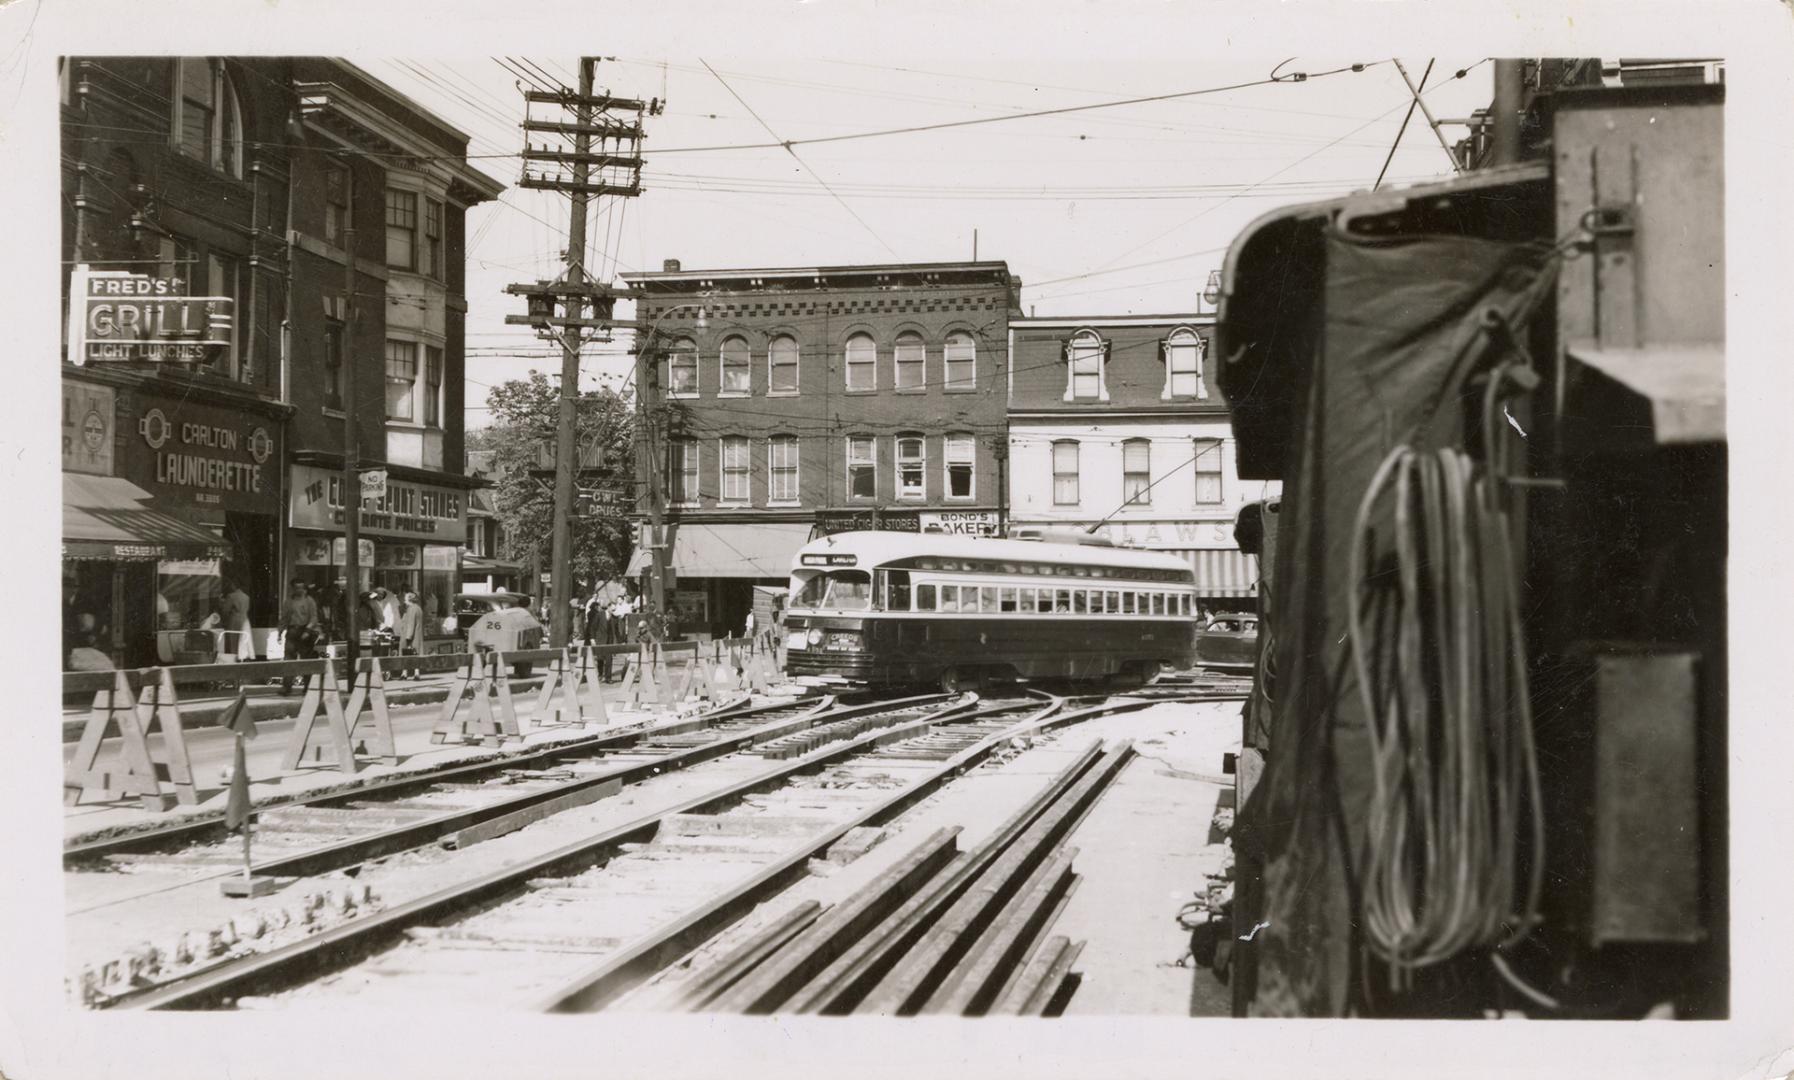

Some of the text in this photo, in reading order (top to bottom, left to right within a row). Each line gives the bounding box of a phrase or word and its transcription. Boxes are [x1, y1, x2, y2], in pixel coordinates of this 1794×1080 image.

[91, 278, 168, 295] FRED'S
[89, 303, 201, 337] GRILL
[89, 343, 205, 359] LIGHT LUNCHES
[181, 422, 238, 451] CARLTON
[156, 452, 262, 493] LAUNDERETTE
[367, 474, 378, 483] NO
[304, 479, 323, 506] THE
[361, 479, 385, 493] PARKING
[592, 491, 620, 504] OWL
[361, 513, 391, 530] RATE
[395, 517, 436, 534] PRICES
[824, 518, 919, 530] UNITED CIGR STORES
[940, 512, 989, 522] BOND'S
[485, 621, 502, 631] 26
